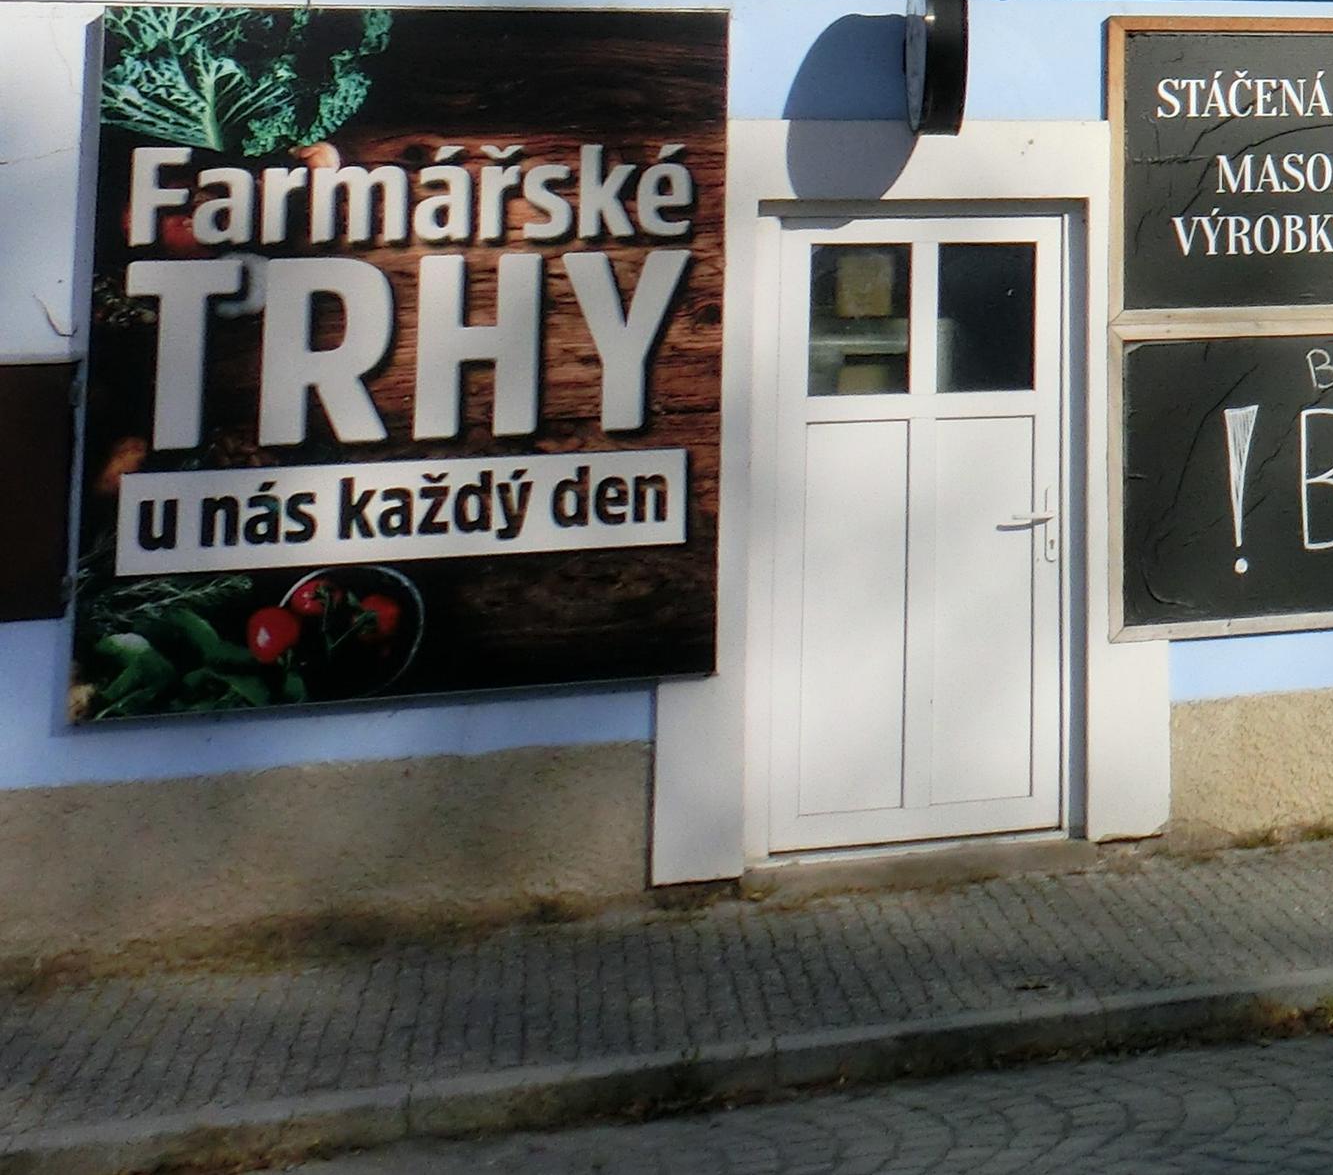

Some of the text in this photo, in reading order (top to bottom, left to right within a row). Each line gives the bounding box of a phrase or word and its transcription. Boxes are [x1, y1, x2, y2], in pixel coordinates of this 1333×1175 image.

[1156, 70, 1333, 119] STÁČENÁ
[128, 143, 694, 248] Farmářské
[126, 248, 692, 452] TRHY
[136, 466, 669, 551] u nás každý den
